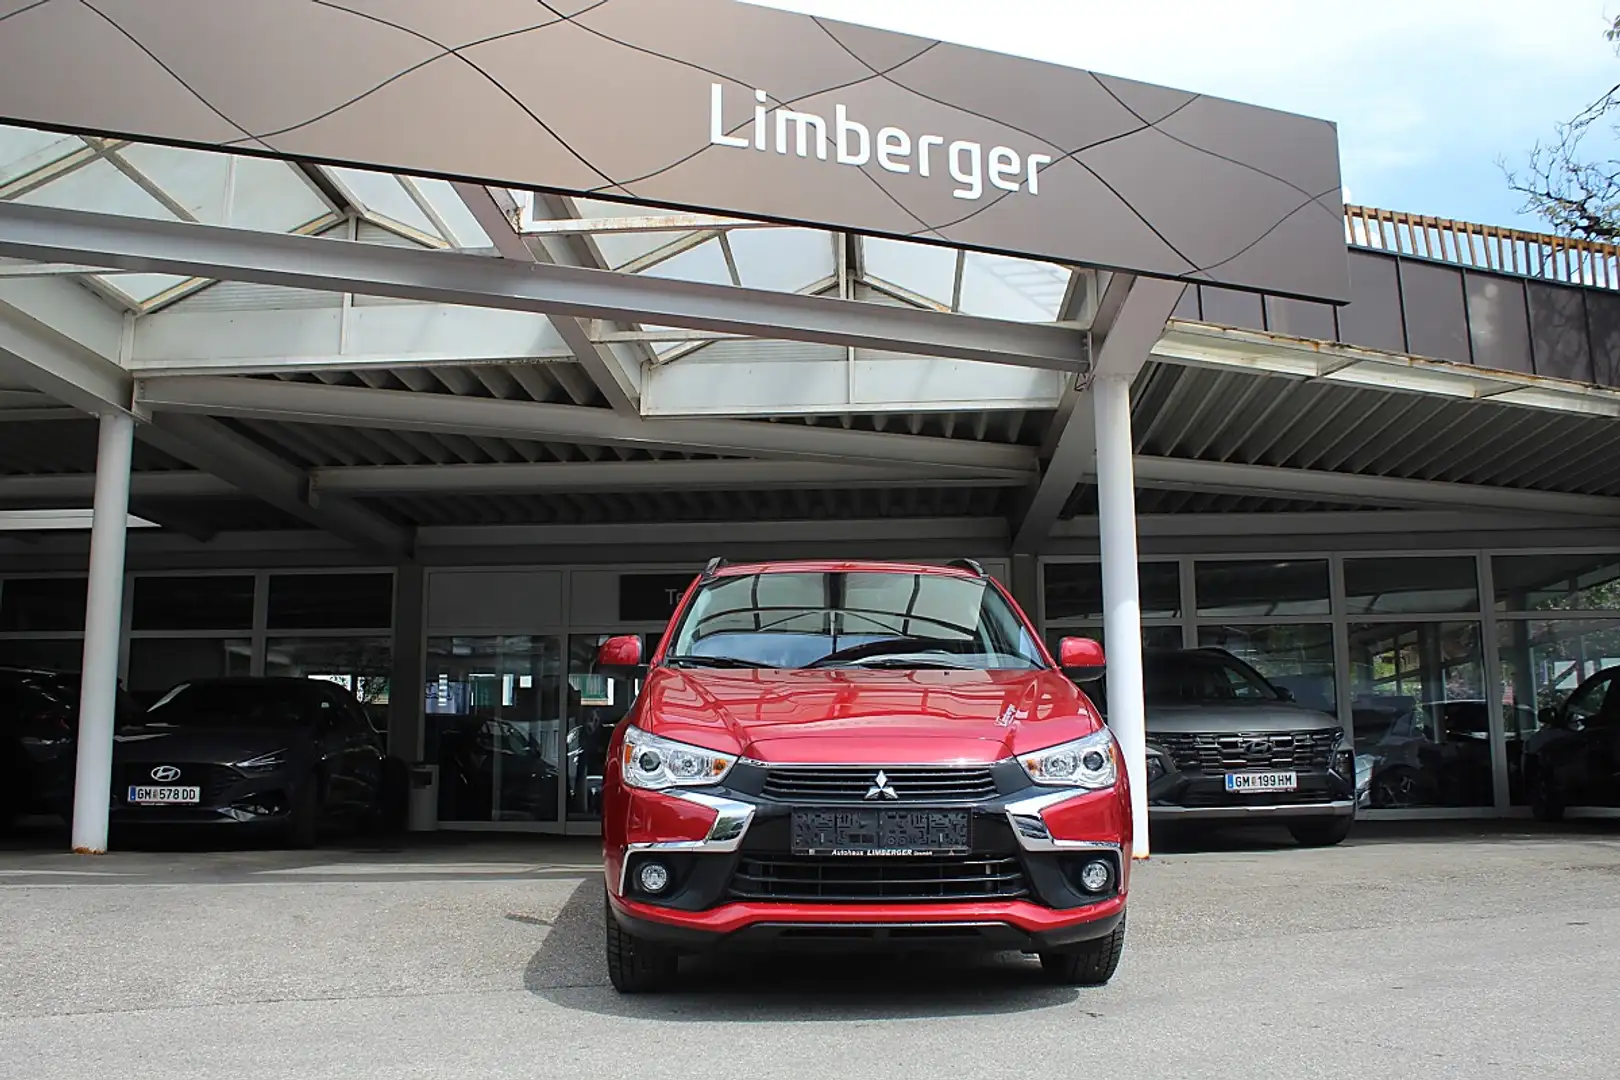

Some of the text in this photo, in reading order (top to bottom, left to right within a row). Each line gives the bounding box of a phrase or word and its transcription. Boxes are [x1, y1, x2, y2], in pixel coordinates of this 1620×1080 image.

[709, 82, 1052, 201] Limberger
[1235, 774, 1292, 787] GM 199 HM
[137, 788, 196, 800] GM 578 DD
[831, 848, 864, 856] Autohaus
[867, 848, 913, 856] LIMBERGER
